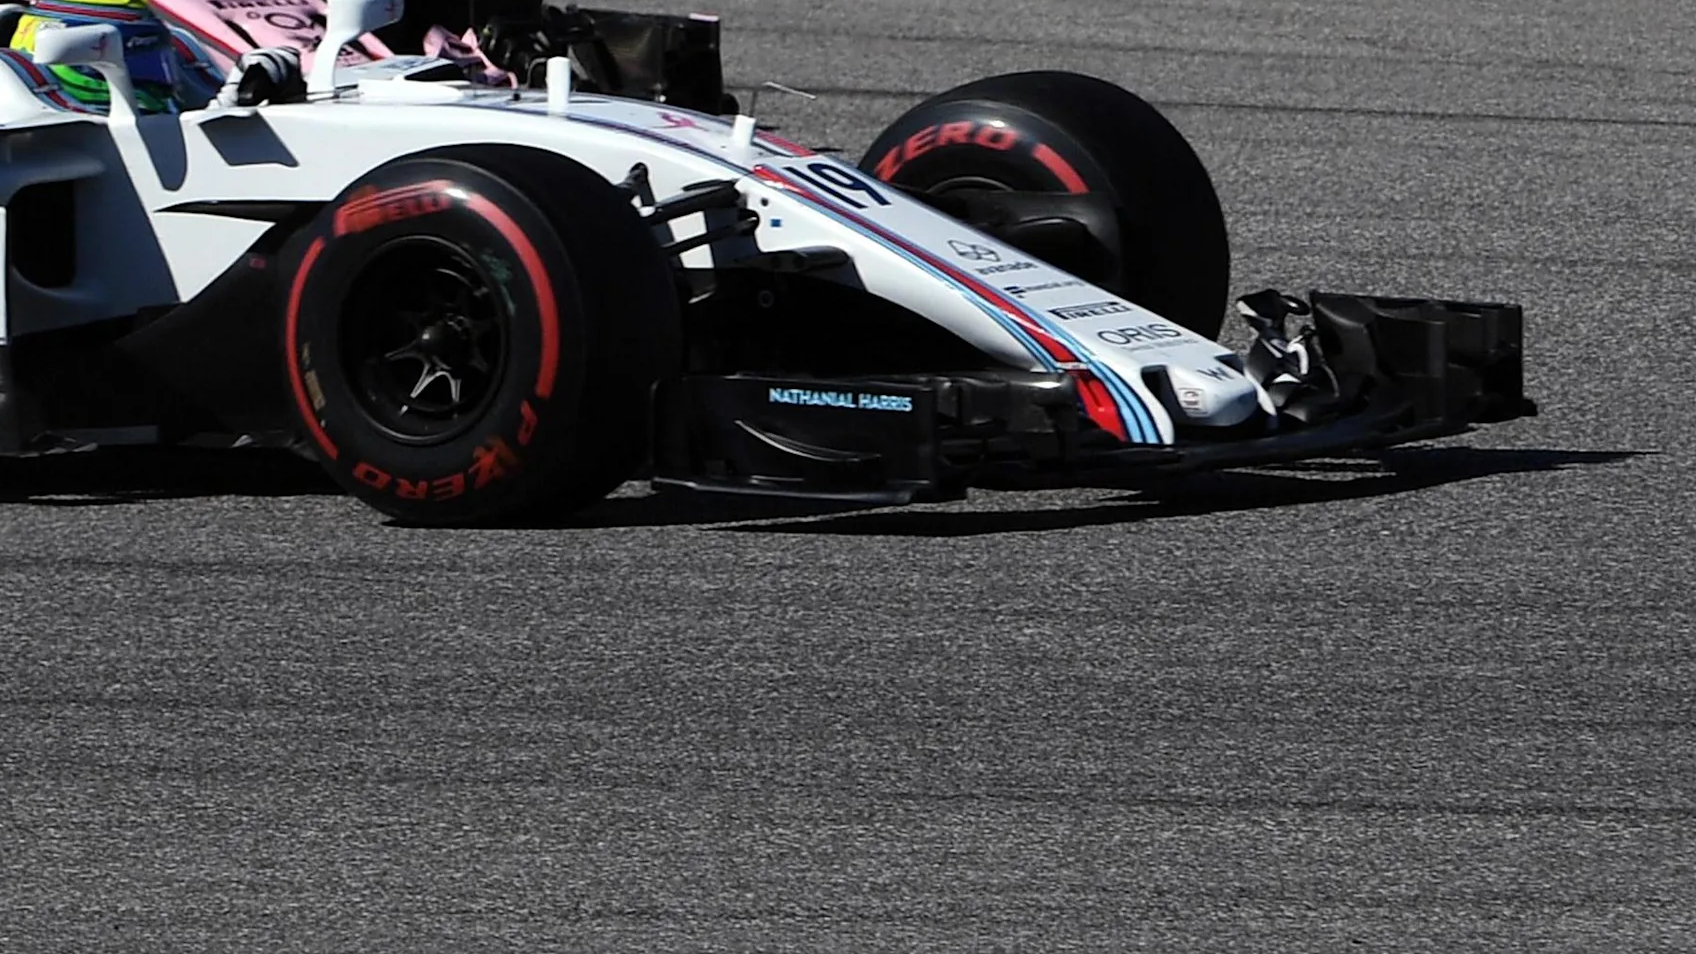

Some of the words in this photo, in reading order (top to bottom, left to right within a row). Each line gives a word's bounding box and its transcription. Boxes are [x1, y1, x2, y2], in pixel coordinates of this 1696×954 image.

[873, 120, 1020, 183] ZERO
[780, 162, 893, 209] 19
[1047, 301, 1133, 321] PIRELLI
[1097, 323, 1182, 346] ORIS
[858, 392, 913, 413] HARRIS
[353, 442, 504, 501] ZERO
